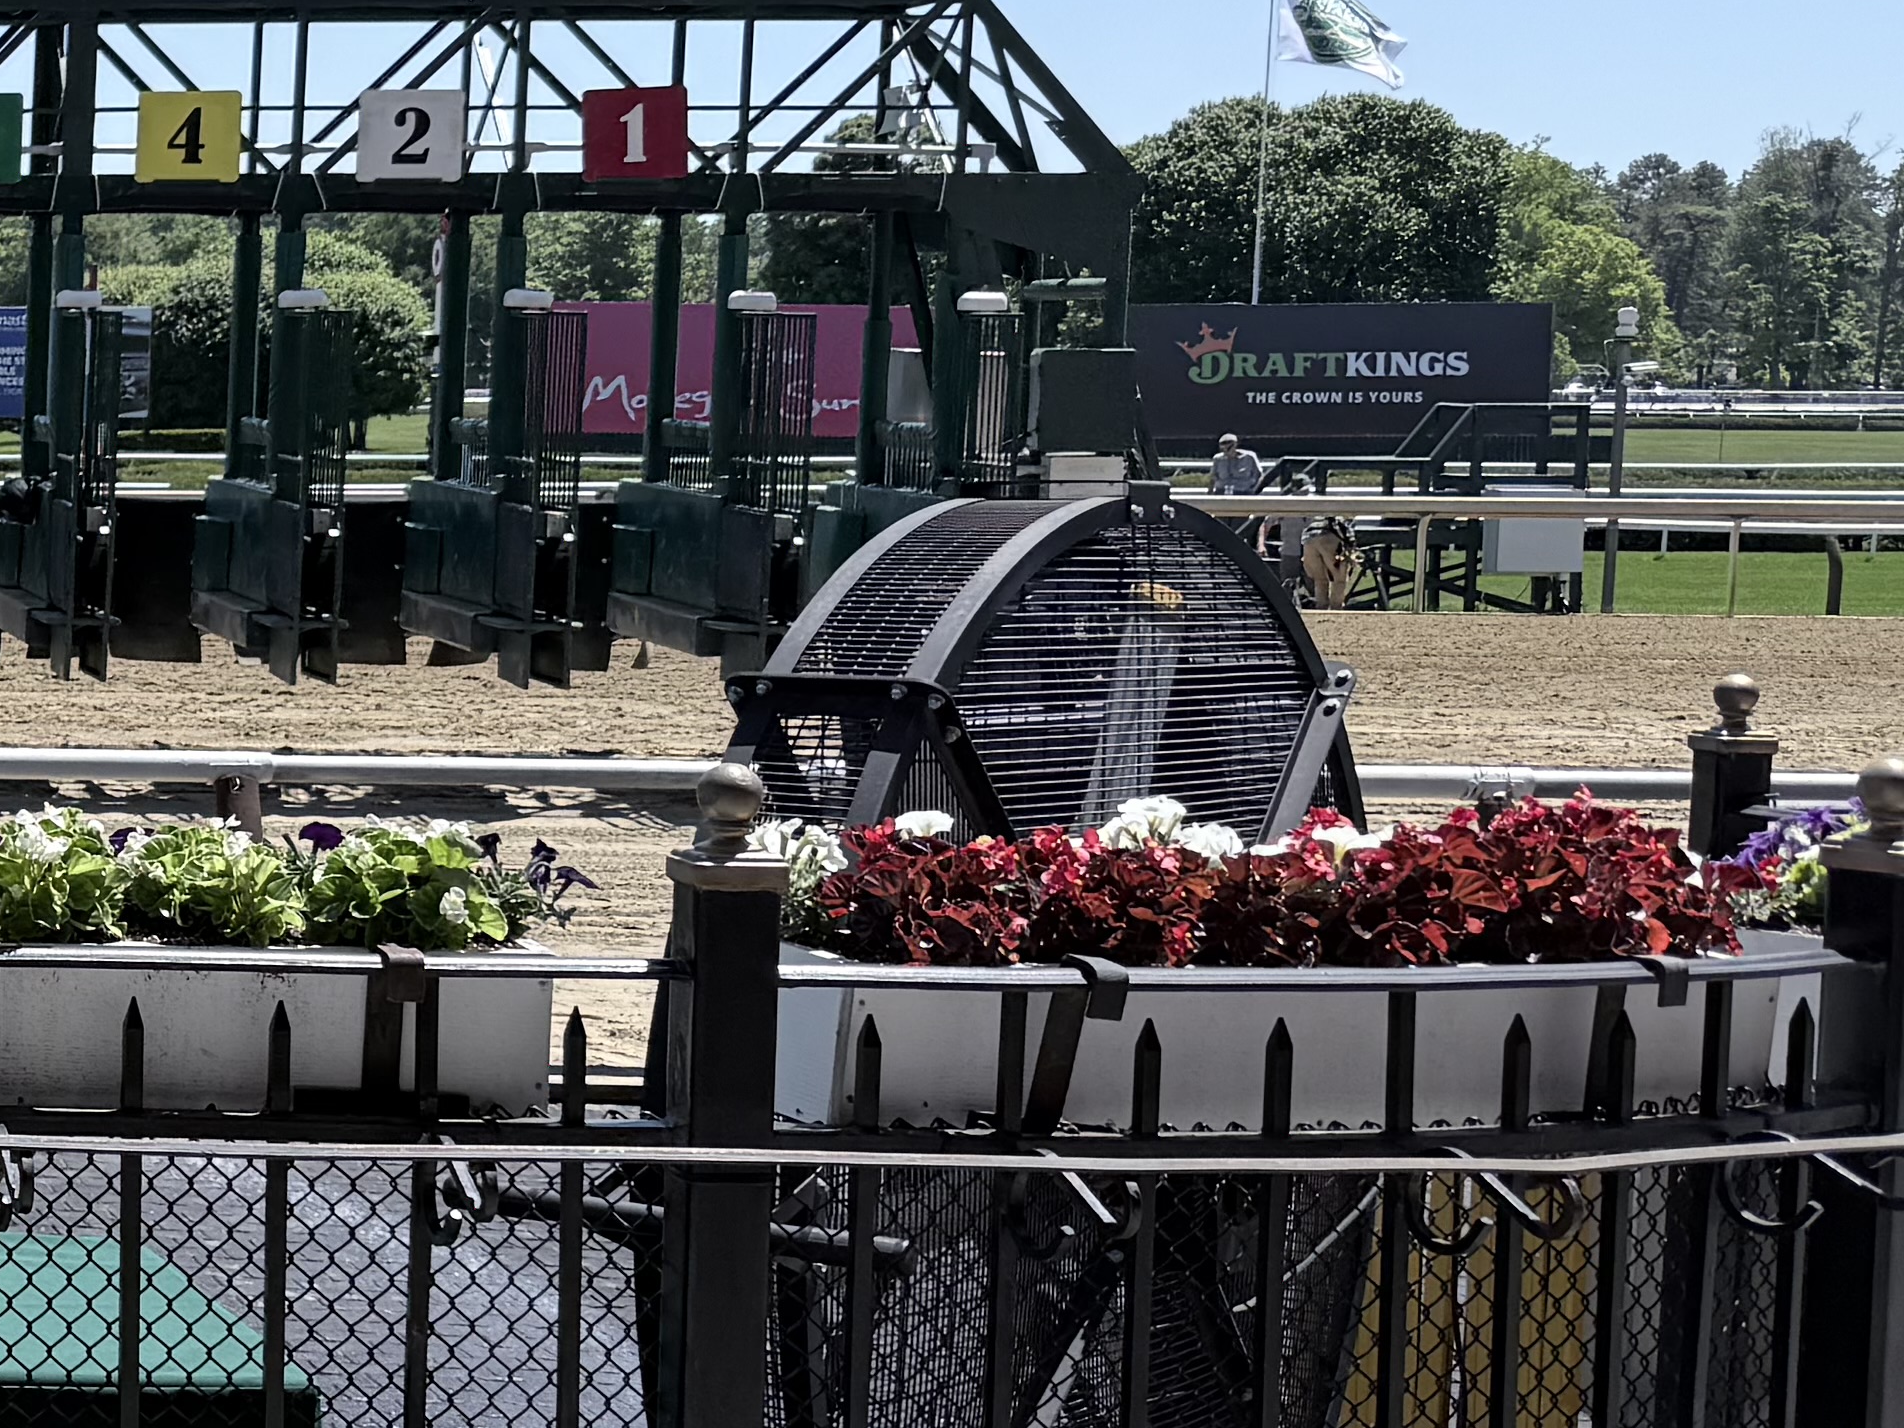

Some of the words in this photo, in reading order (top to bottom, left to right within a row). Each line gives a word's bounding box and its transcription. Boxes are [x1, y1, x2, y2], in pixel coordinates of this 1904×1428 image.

[167, 107, 206, 165] 4
[392, 106, 432, 164] 2
[619, 103, 650, 162] 1
[1188, 350, 1469, 384] DRAFTKINGS
[582, 374, 713, 422] Moeg
[1246, 391, 1276, 404] THE
[1280, 390, 1342, 405] CROWN
[1348, 390, 1363, 404] IS
[1368, 390, 1423, 404] YOURS
